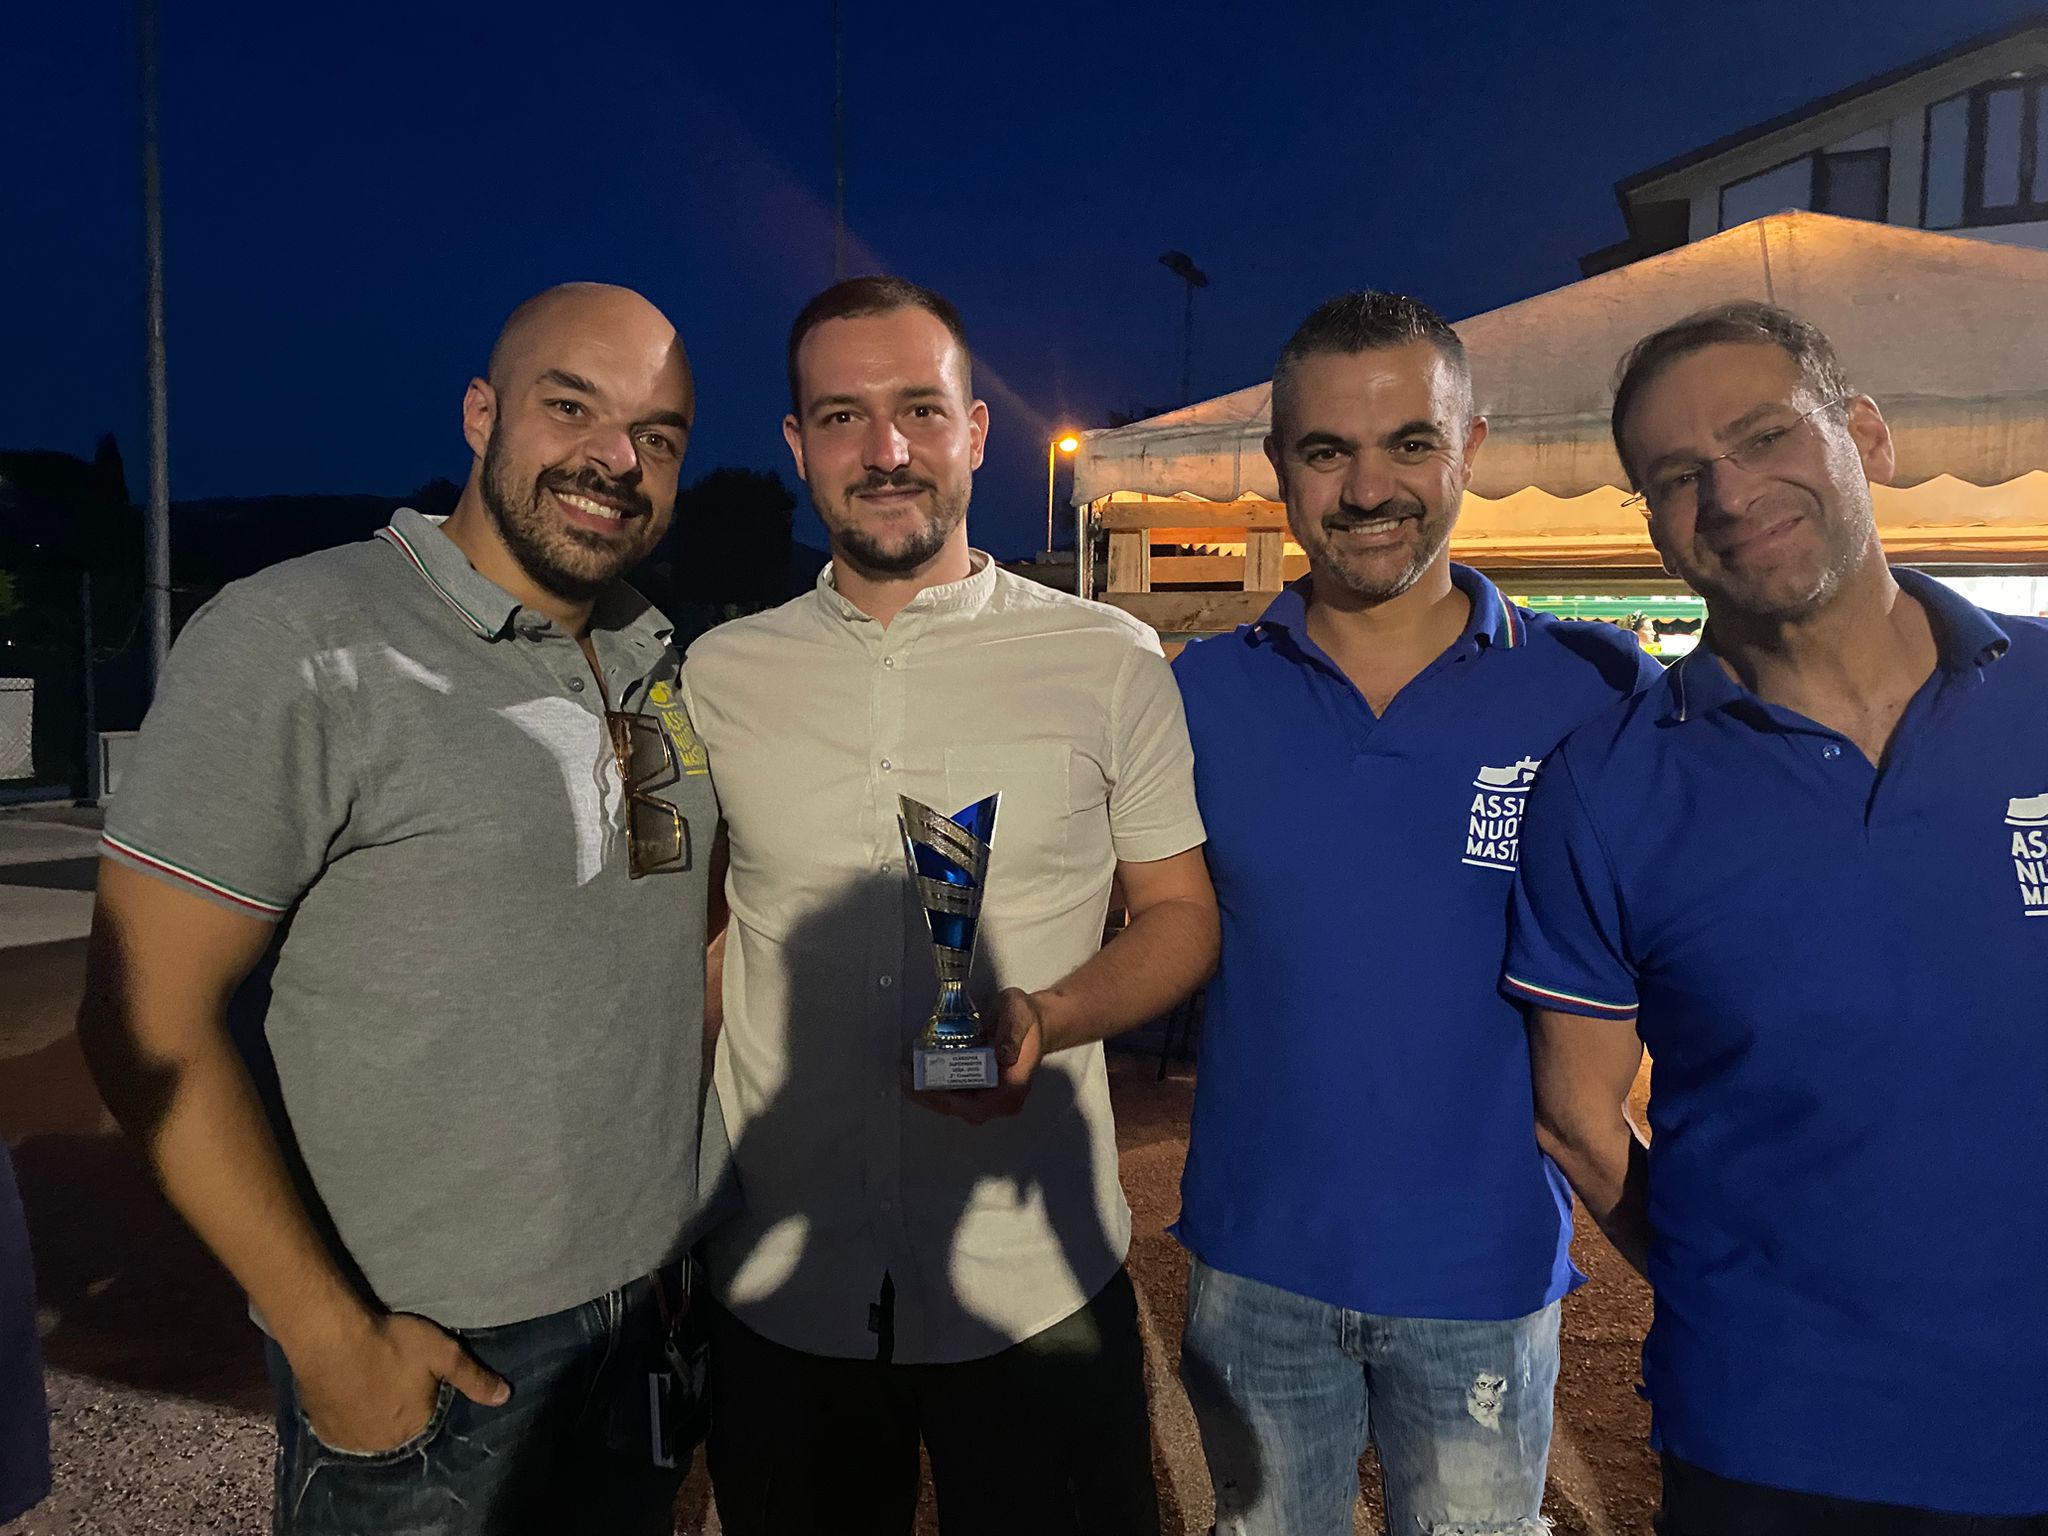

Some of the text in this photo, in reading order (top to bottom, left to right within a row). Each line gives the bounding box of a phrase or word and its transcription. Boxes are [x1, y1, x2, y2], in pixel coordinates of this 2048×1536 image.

[1469, 814, 1522, 840] NUO
[1465, 835, 1519, 862] MAST
[2011, 830, 2048, 859] AS
